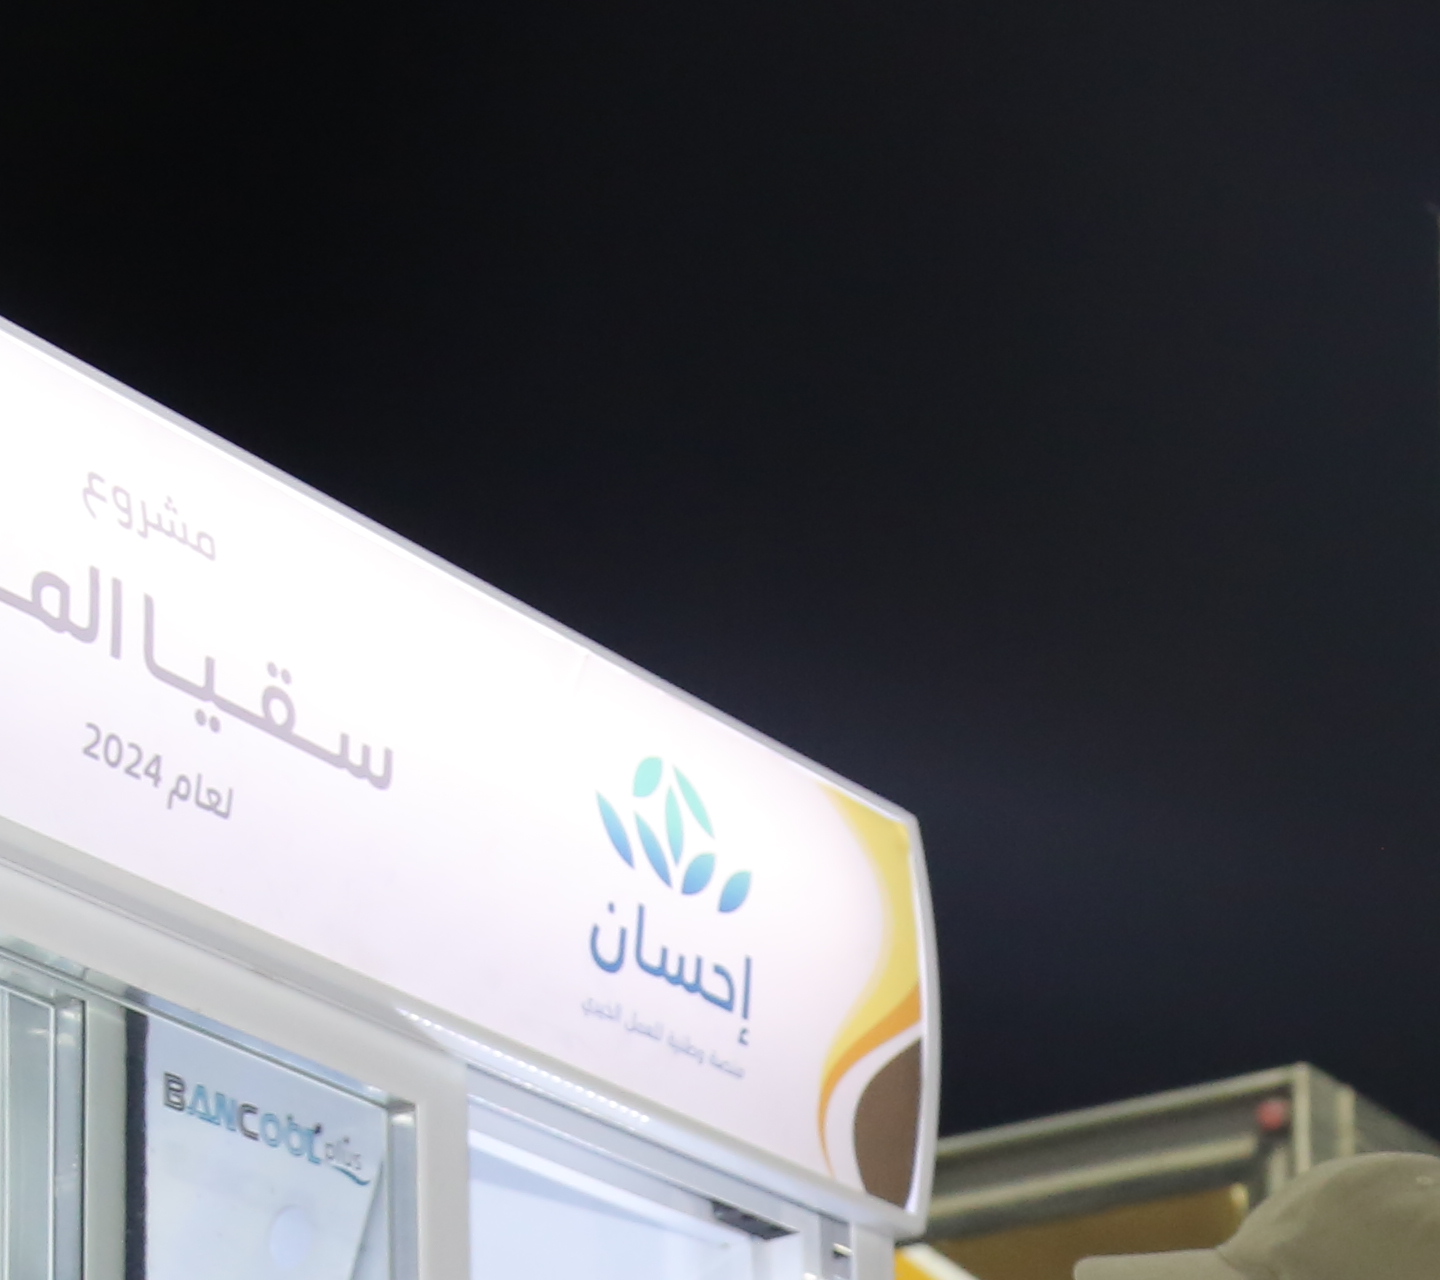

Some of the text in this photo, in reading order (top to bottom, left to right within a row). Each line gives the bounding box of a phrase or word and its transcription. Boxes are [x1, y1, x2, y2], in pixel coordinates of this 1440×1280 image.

[81, 470, 217, 562] مشروع
[142, 591, 395, 791] سقيا
[81, 721, 235, 821] لعام 2024
[587, 900, 754, 1047] إحسان
